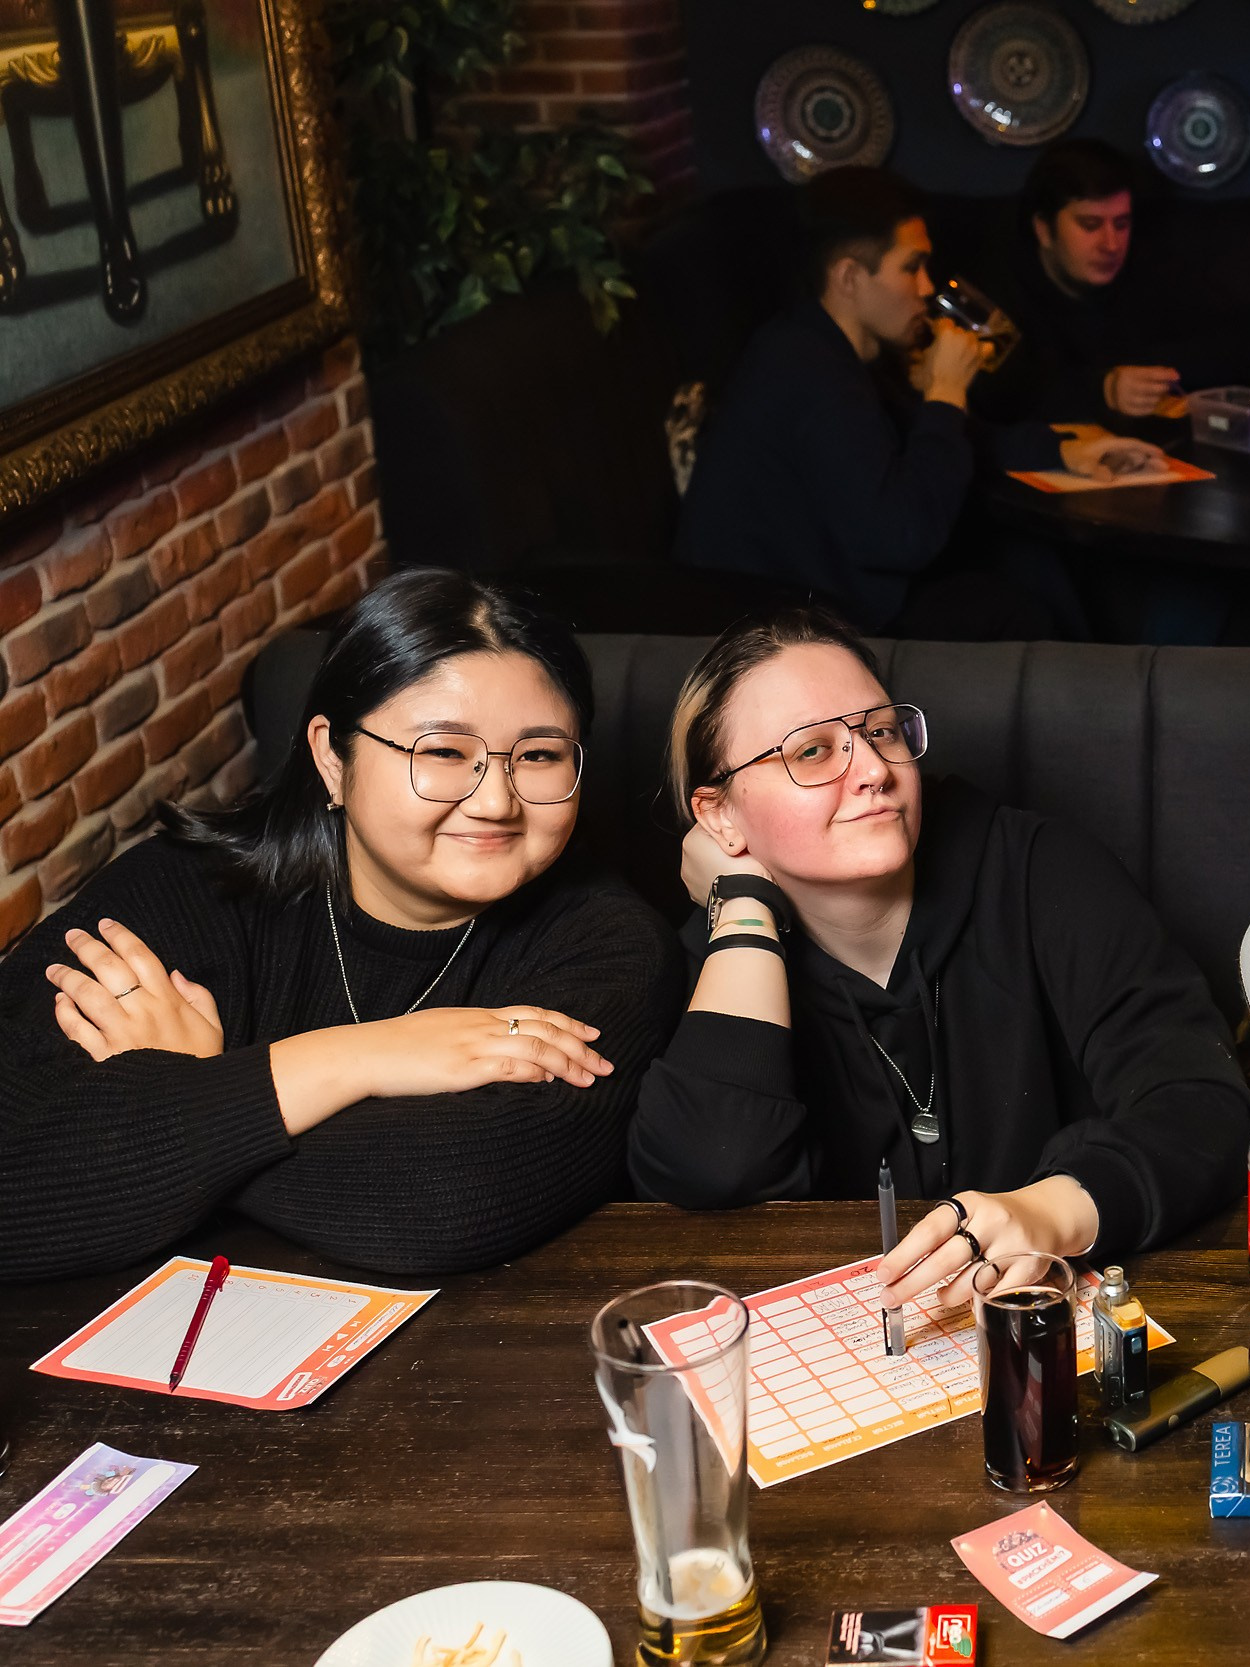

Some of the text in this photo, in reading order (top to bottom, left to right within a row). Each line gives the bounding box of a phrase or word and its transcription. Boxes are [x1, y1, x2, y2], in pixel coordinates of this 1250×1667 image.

[822, 1435, 862, 1452] СЕДЬМОЙ
[1214, 1426, 1232, 1468] TEREA
[1007, 1542, 1048, 1567] QUIZ
